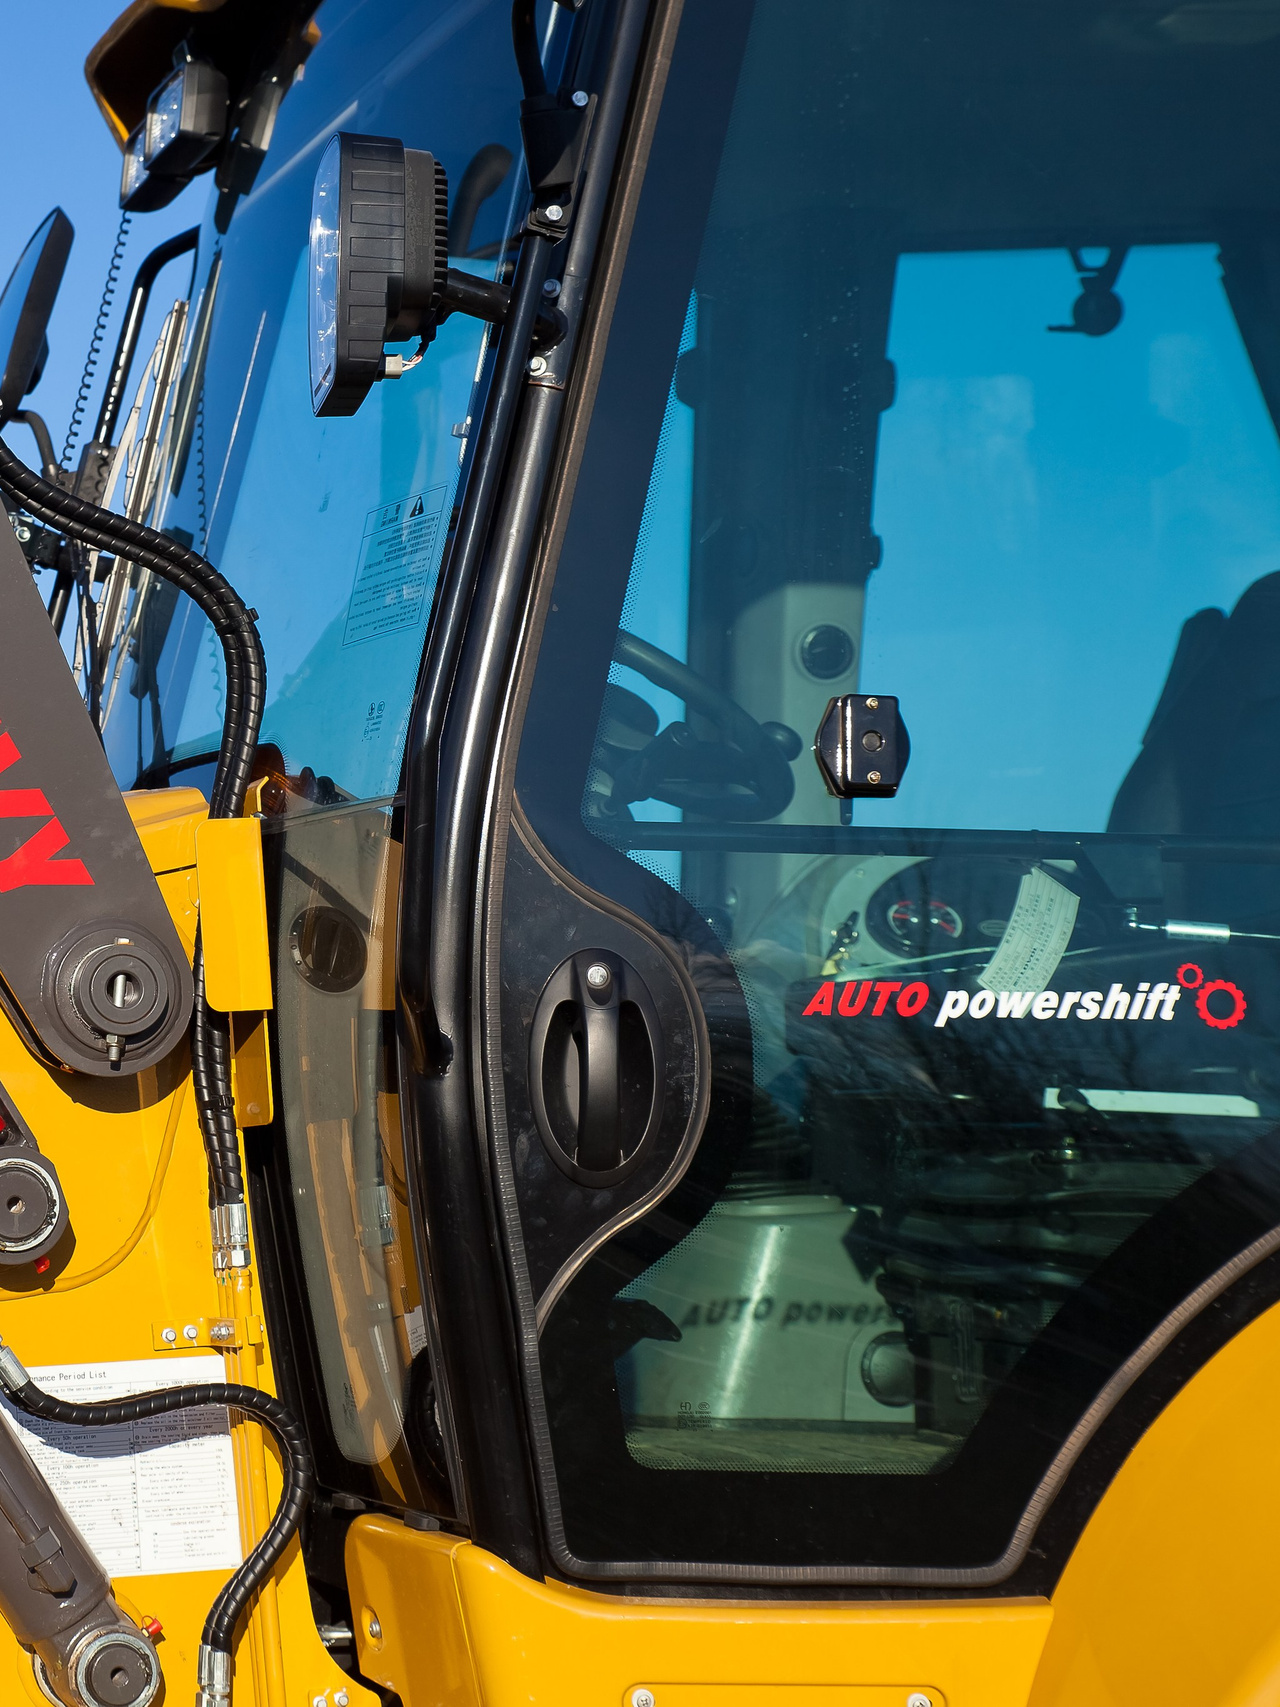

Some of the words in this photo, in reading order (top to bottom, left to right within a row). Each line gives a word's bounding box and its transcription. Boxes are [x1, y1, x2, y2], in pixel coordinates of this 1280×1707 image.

[802, 981, 930, 1016] AUTO
[934, 983, 1182, 1027] powershift
[59, 1371, 86, 1381] Period
[89, 1370, 107, 1379] List
